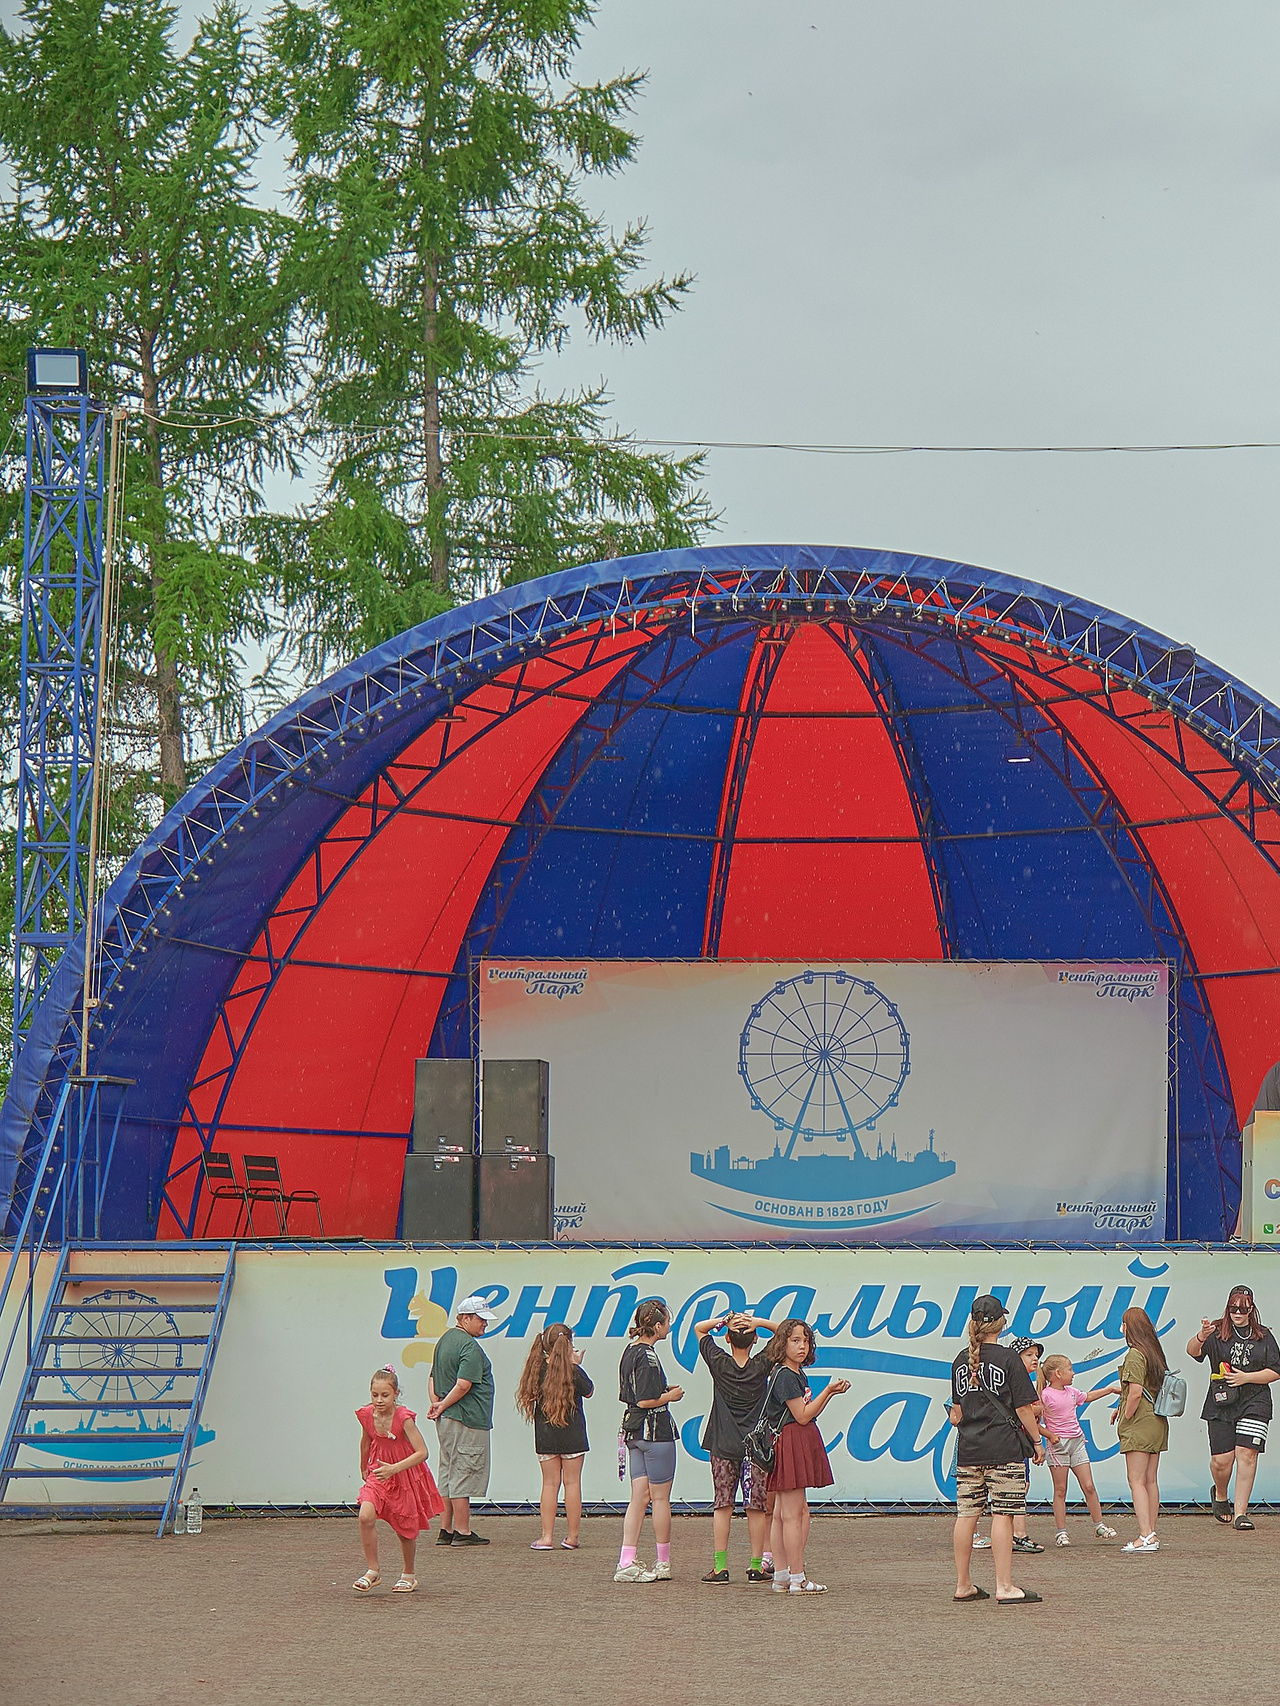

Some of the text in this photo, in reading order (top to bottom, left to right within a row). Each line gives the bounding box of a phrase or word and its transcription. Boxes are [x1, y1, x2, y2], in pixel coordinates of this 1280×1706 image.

[488, 968, 588, 983] Центральный
[1058, 971, 1159, 985] Центральный
[526, 982, 585, 1000] Парк
[1096, 984, 1155, 1003] Парк
[754, 1199, 889, 1218] ОСНОВАН В 1828 ГОДУ
[1056, 1201, 1158, 1217] Центральный
[1094, 1215, 1152, 1234] Парк
